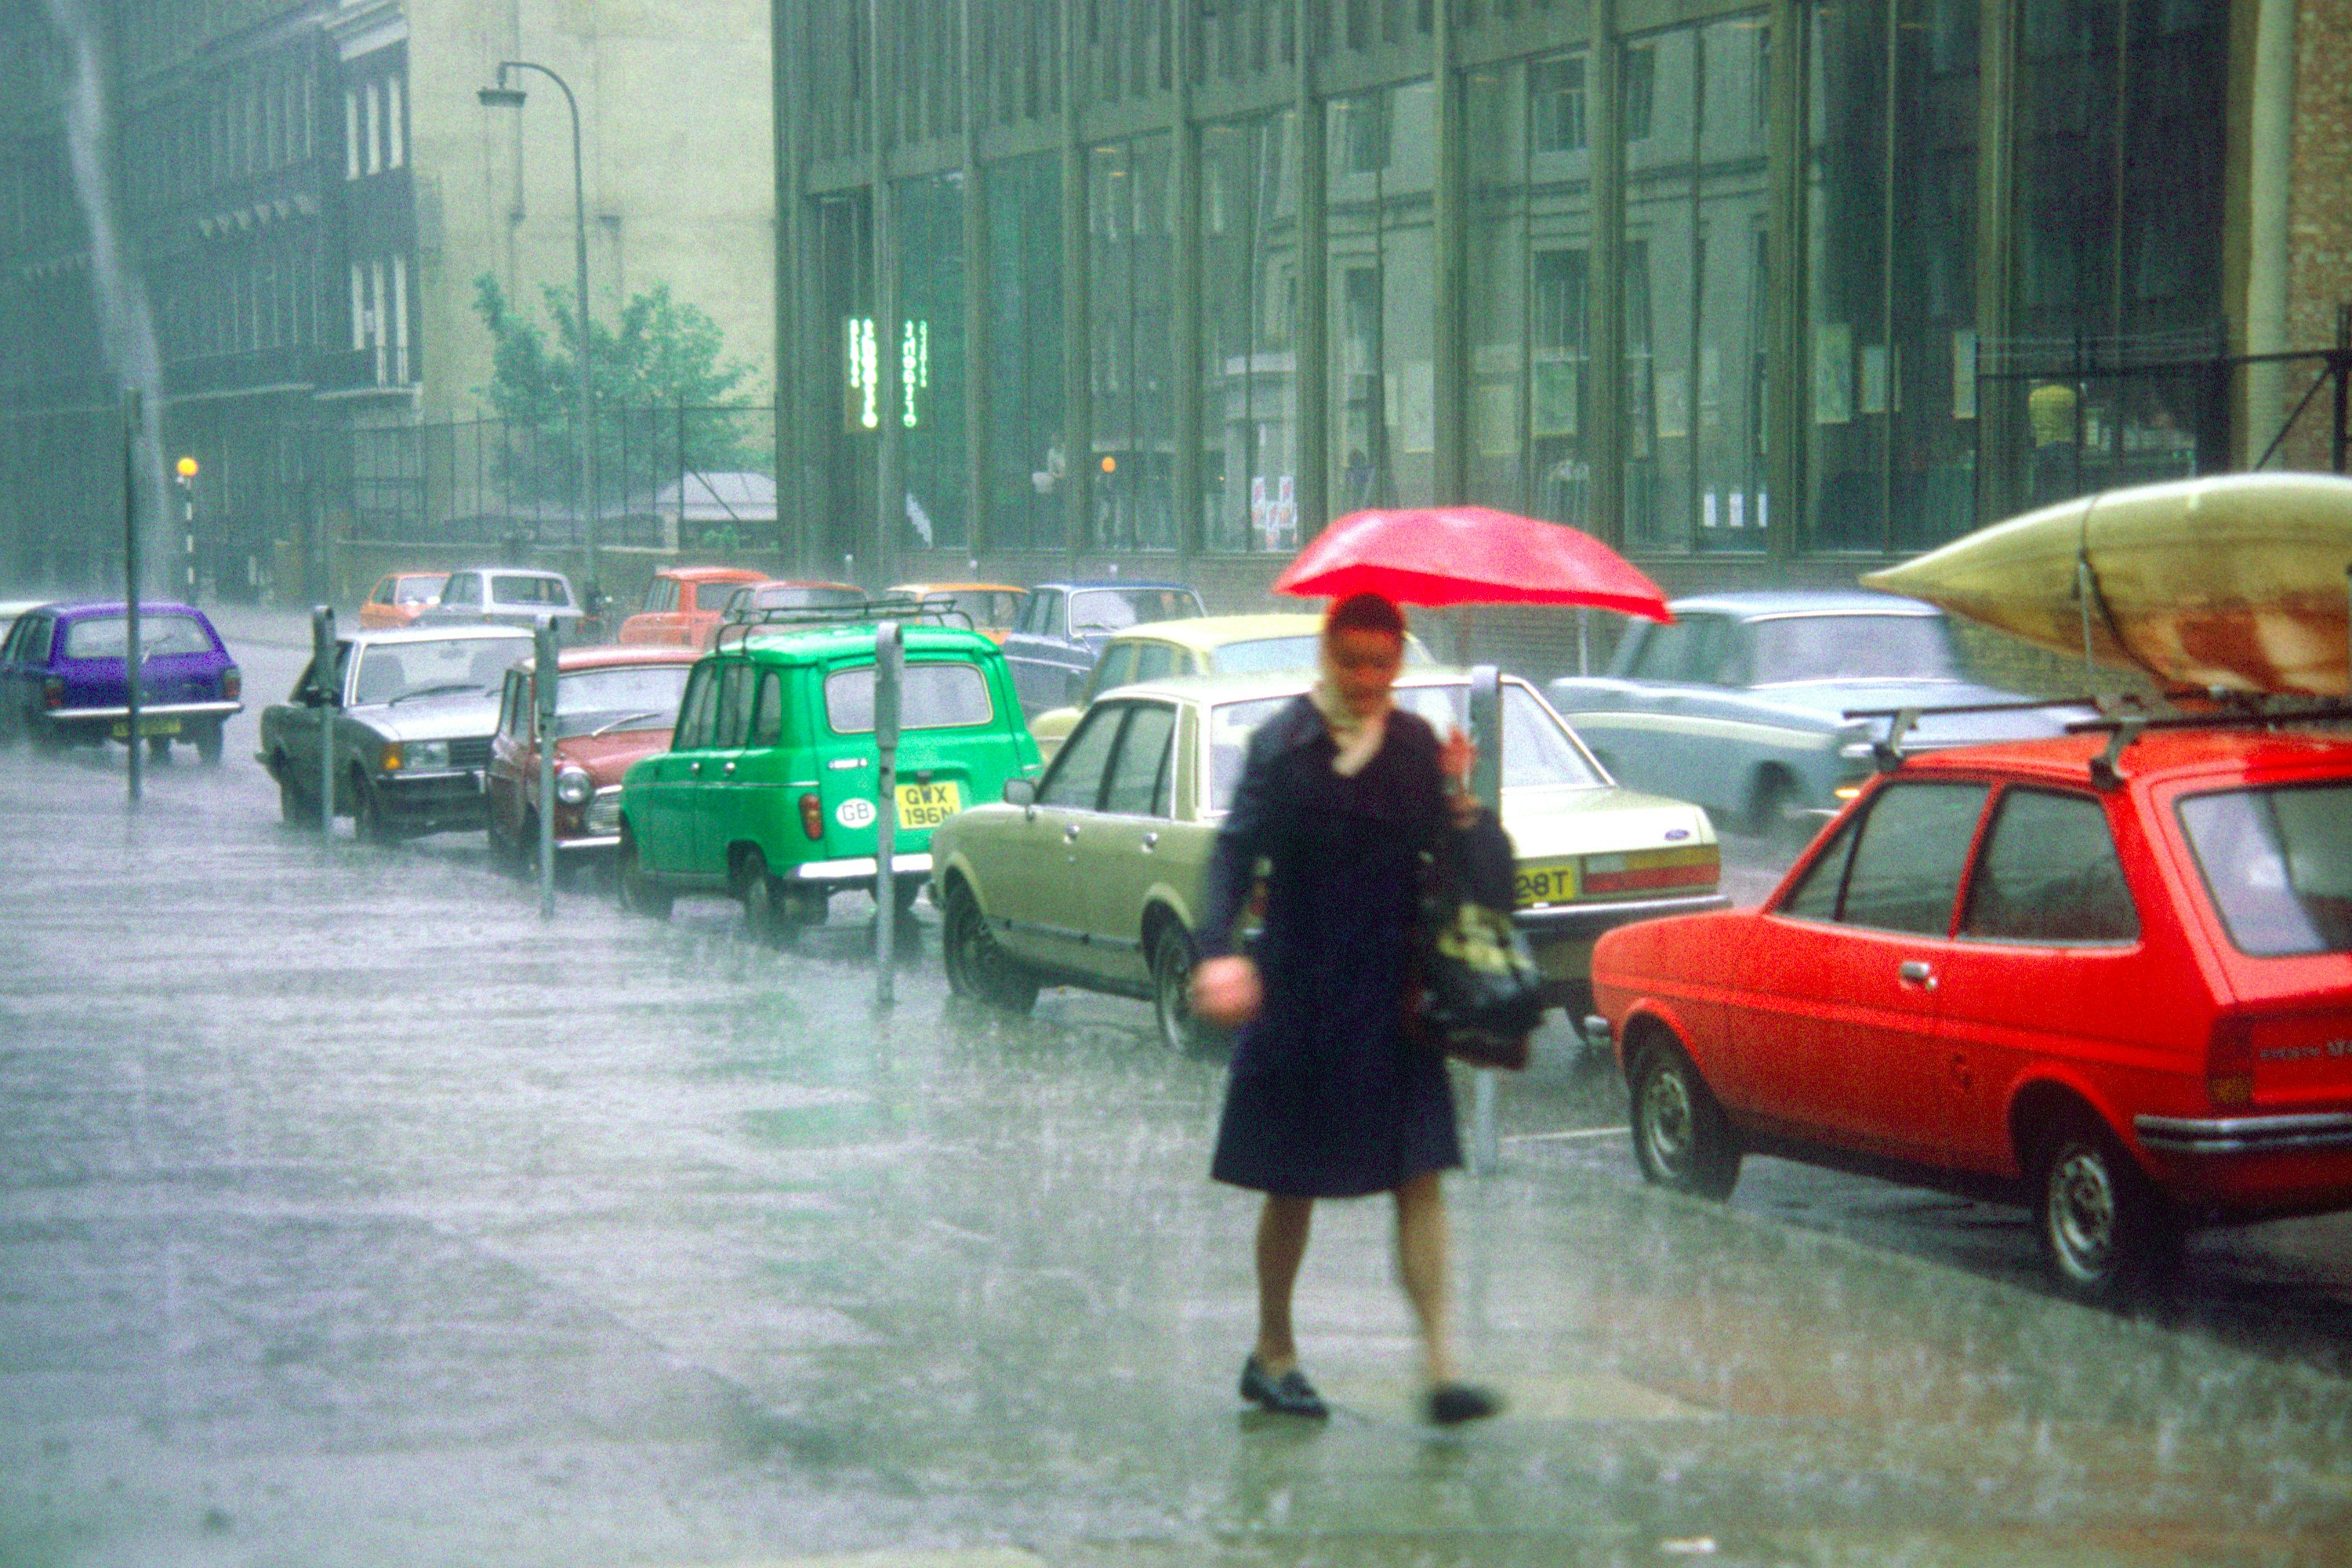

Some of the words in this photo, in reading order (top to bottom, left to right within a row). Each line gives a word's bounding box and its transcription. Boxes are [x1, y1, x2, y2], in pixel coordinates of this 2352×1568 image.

[905, 786, 948, 805] GWX
[842, 803, 869, 822] GB
[905, 805, 953, 826] 196N
